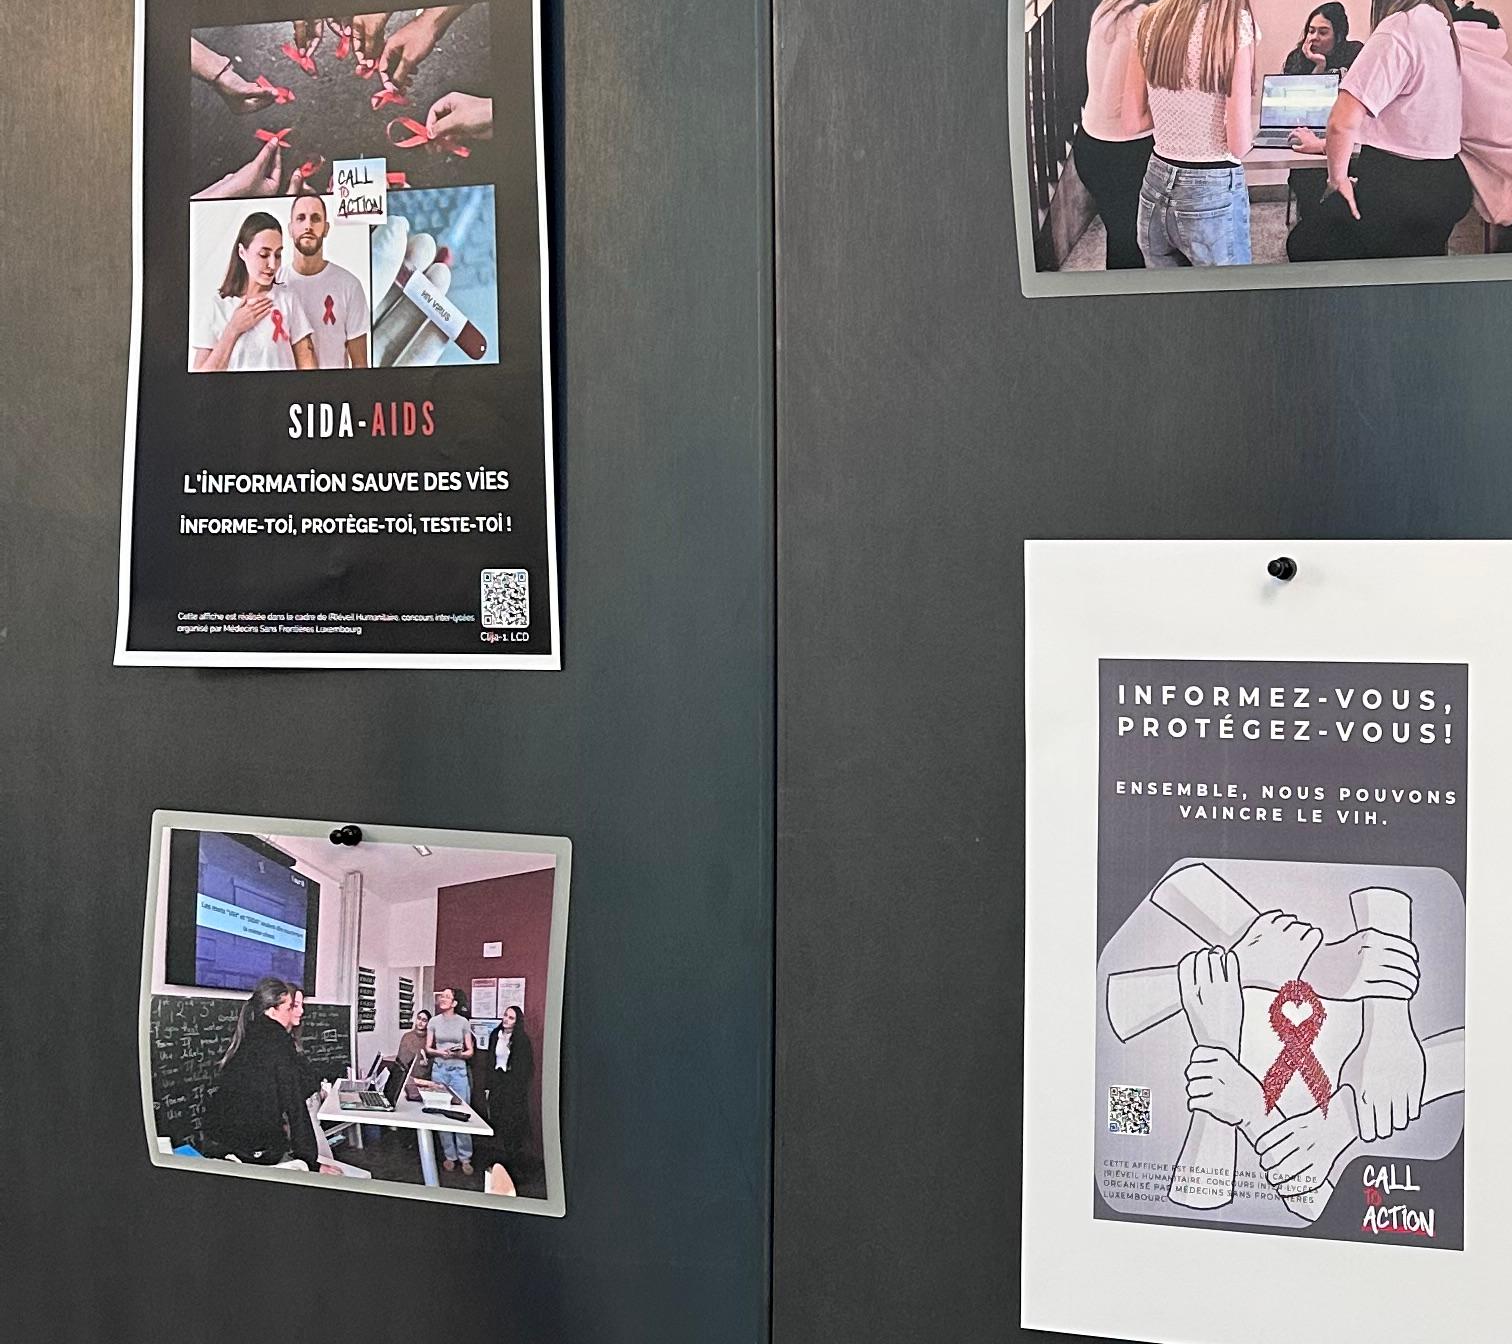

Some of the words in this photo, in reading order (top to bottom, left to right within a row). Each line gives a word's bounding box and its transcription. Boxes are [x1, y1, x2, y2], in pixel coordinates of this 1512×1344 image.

[337, 165, 373, 188] CALL
[338, 194, 383, 218] ACTION
[288, 400, 436, 439] SIDA-AIDS
[351, 471, 419, 493] SAUVE
[424, 470, 462, 492] DES
[510, 631, 530, 642] LCD
[1117, 684, 1452, 715] INFORMEZ-VOUS,
[1117, 714, 1453, 745] PROTÉGEZ-VOUS!
[1116, 780, 1248, 801] ENSEMBLE,
[1262, 785, 1326, 802] NOUS
[1339, 786, 1457, 806] POUVONS
[1179, 805, 1284, 823] VAINCRE
[1297, 809, 1323, 824] LE
[1337, 810, 1388, 826] VIH.
[1103, 1159, 1129, 1169] CETTE
[1132, 1161, 1169, 1171] AFFICHE
[1305, 1175, 1317, 1184] DE
[1362, 1163, 1421, 1195] CALL
[1103, 1179, 1151, 1190] ORGANISÉ
[1175, 1184, 1224, 1197] MÉDECINS
[1362, 1204, 1435, 1238] ACTION
